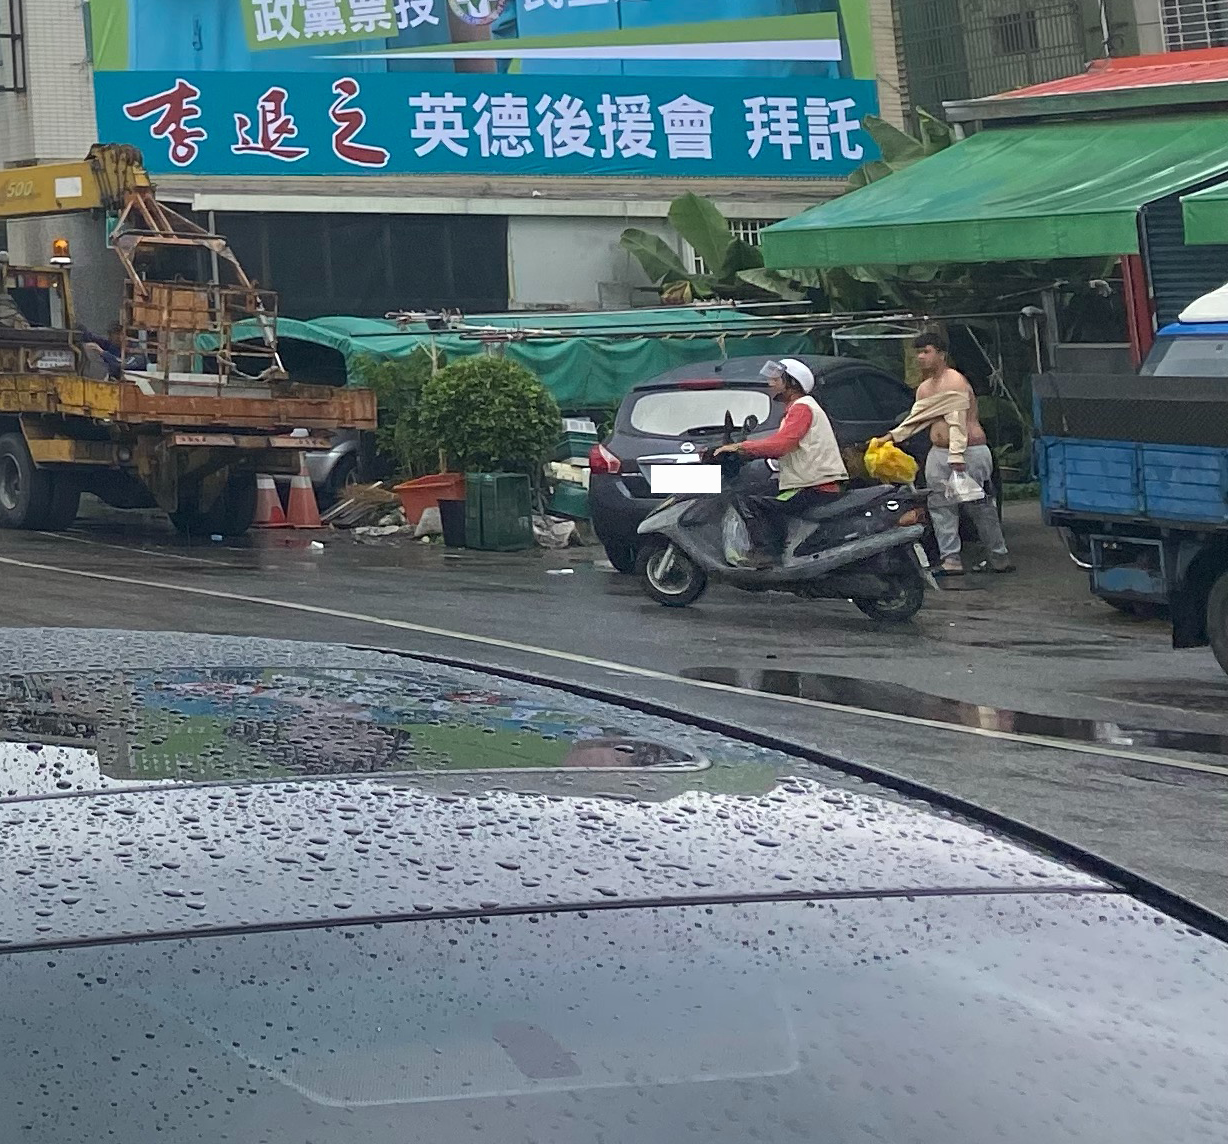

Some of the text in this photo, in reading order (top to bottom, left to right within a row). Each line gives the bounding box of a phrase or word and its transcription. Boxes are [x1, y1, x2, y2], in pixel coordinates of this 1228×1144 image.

[122, 77, 864, 168] 李退之 英德後援會 拜託
[6, 180, 34, 198] 500
